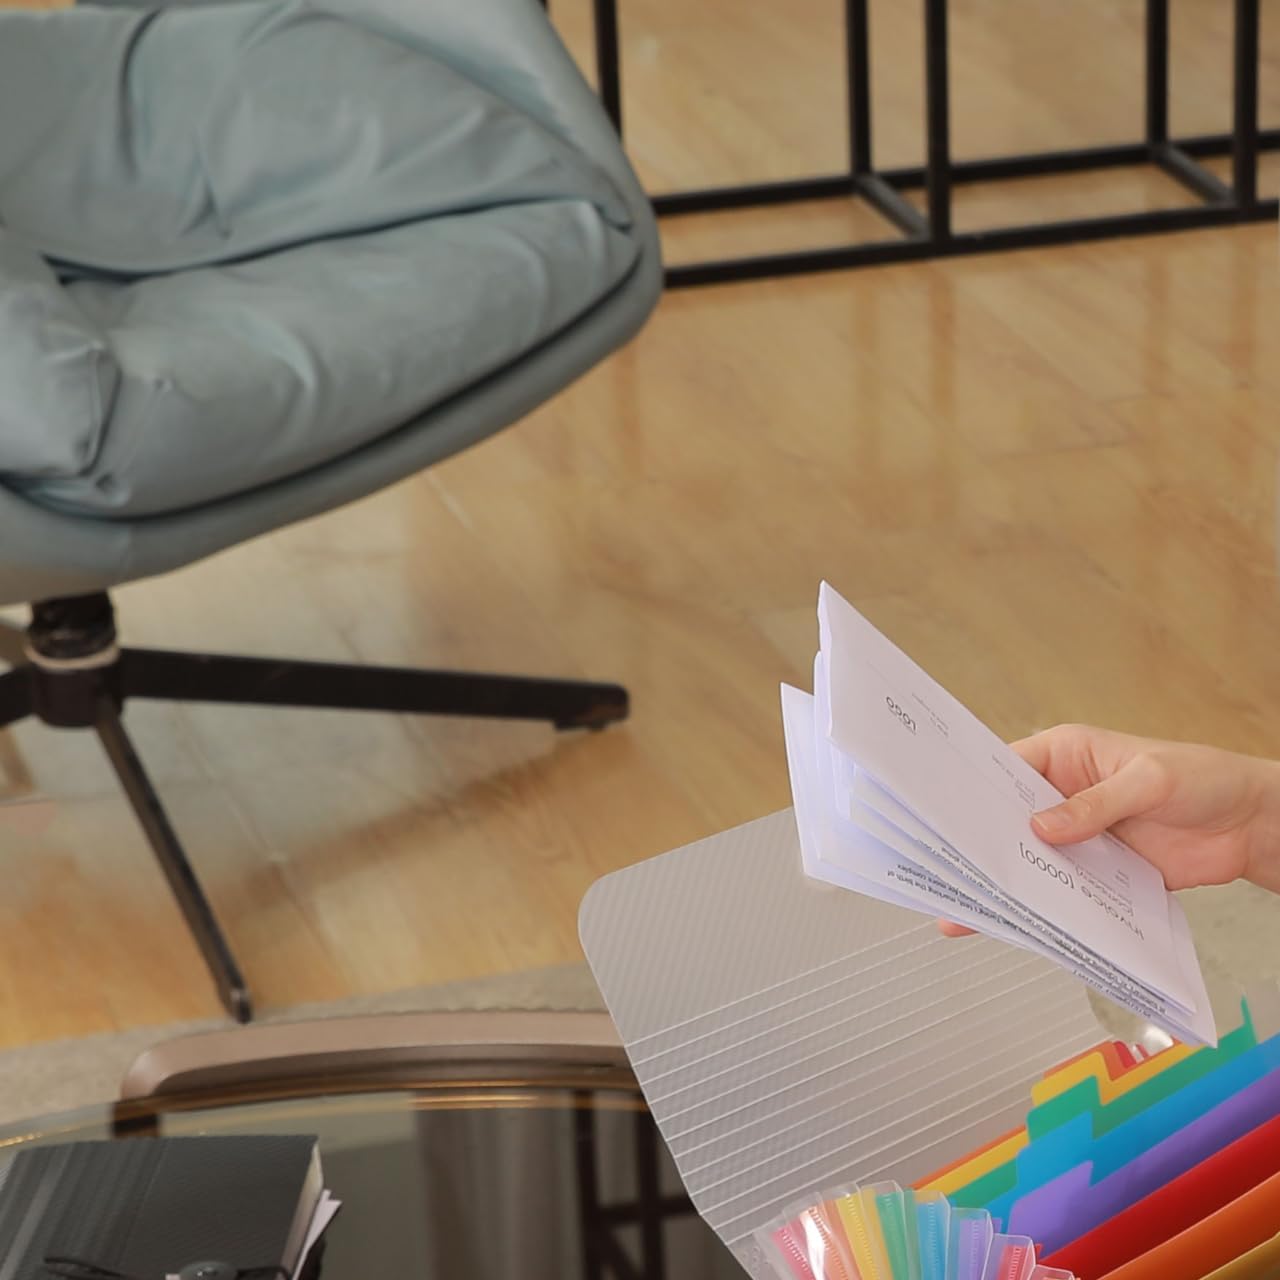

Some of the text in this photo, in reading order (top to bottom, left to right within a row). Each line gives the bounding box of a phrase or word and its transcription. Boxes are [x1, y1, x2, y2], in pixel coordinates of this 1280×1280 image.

[885, 696, 917, 732] LOGO
[896, 872, 914, 886] birth
[913, 880, 927, 891] the
[926, 885, 956, 903] marking
[1081, 886, 1145, 941] Invoice
